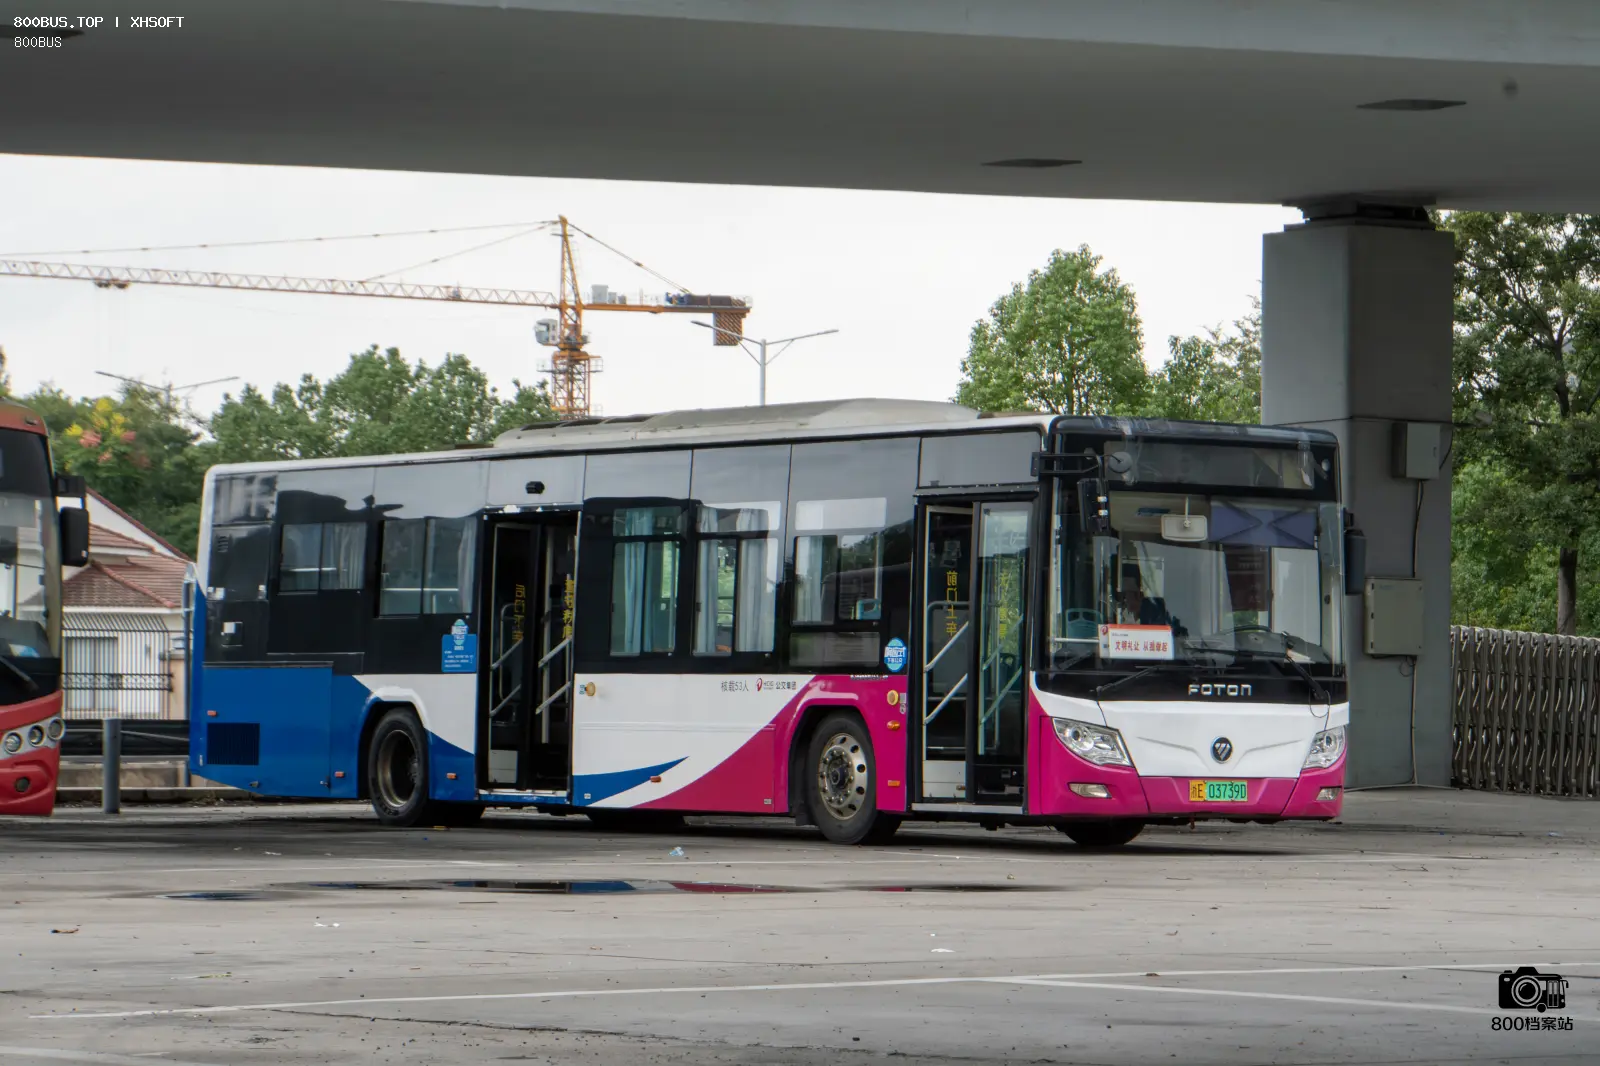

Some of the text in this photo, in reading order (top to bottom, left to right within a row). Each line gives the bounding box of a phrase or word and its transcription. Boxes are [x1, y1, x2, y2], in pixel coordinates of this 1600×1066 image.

[721, 680, 749, 692] 核载53人
[775, 681, 797, 690] 公交集团
[1188, 684, 1252, 696] FOTON
